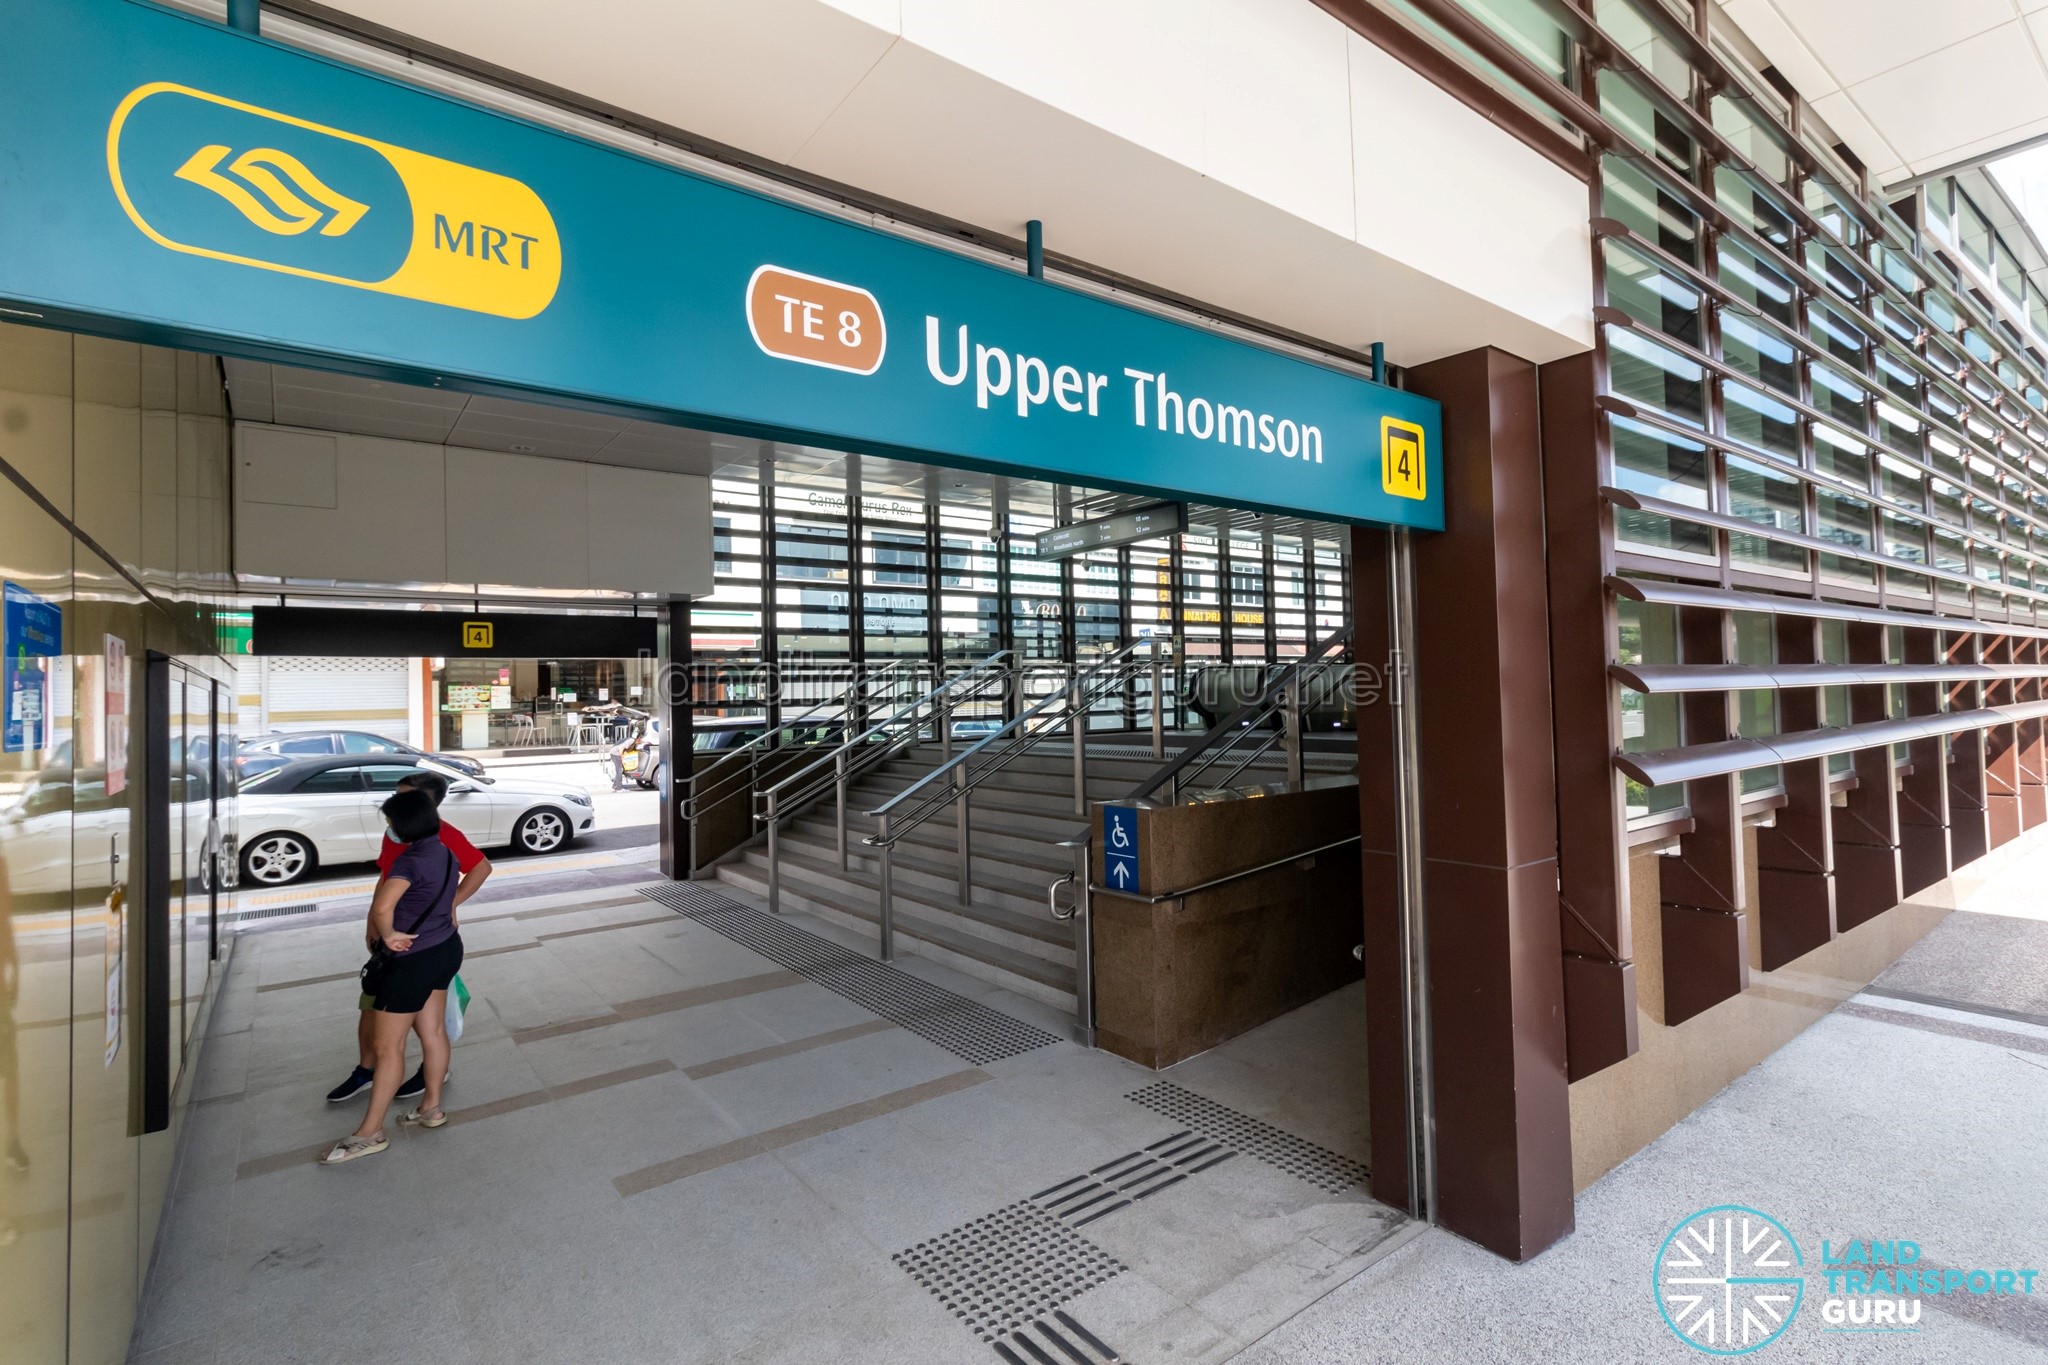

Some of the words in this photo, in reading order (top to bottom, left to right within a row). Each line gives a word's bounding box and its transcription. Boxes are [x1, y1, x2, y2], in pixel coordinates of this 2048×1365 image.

[434, 213, 539, 270] MRT
[775, 294, 824, 340] TE
[838, 310, 862, 348] 8
[925, 315, 1108, 418] Upper
[1123, 367, 1323, 464] Thomson
[1397, 448, 1411, 482] 4
[474, 631, 483, 642] 4
